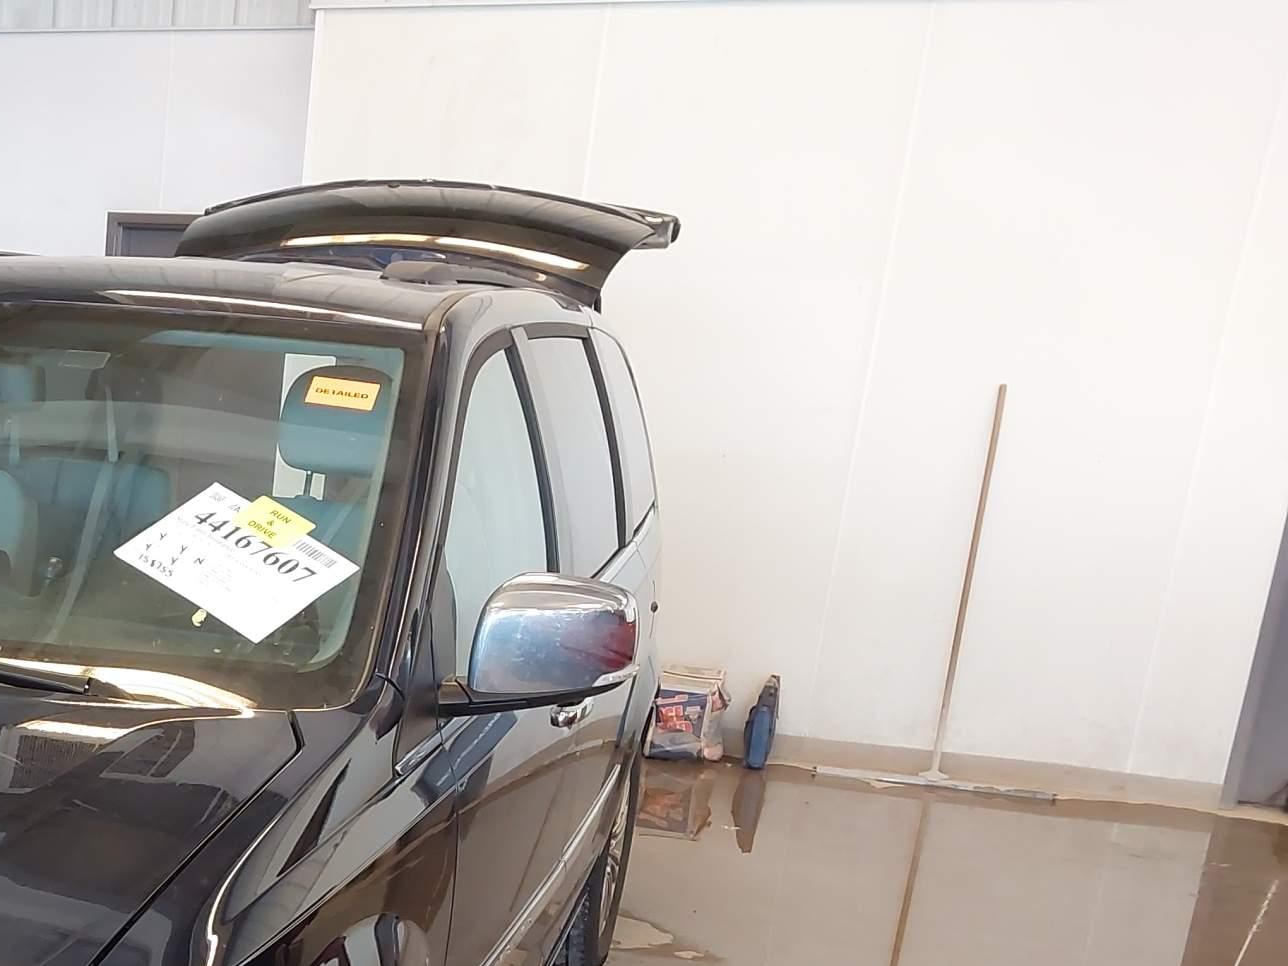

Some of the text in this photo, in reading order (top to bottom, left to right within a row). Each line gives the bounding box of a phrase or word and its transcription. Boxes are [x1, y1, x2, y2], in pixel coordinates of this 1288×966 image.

[315, 387, 369, 399] DETAILED
[270, 509, 292, 525] RUN
[247, 519, 277, 540] DRIVE
[194, 511, 317, 583] 44167607
